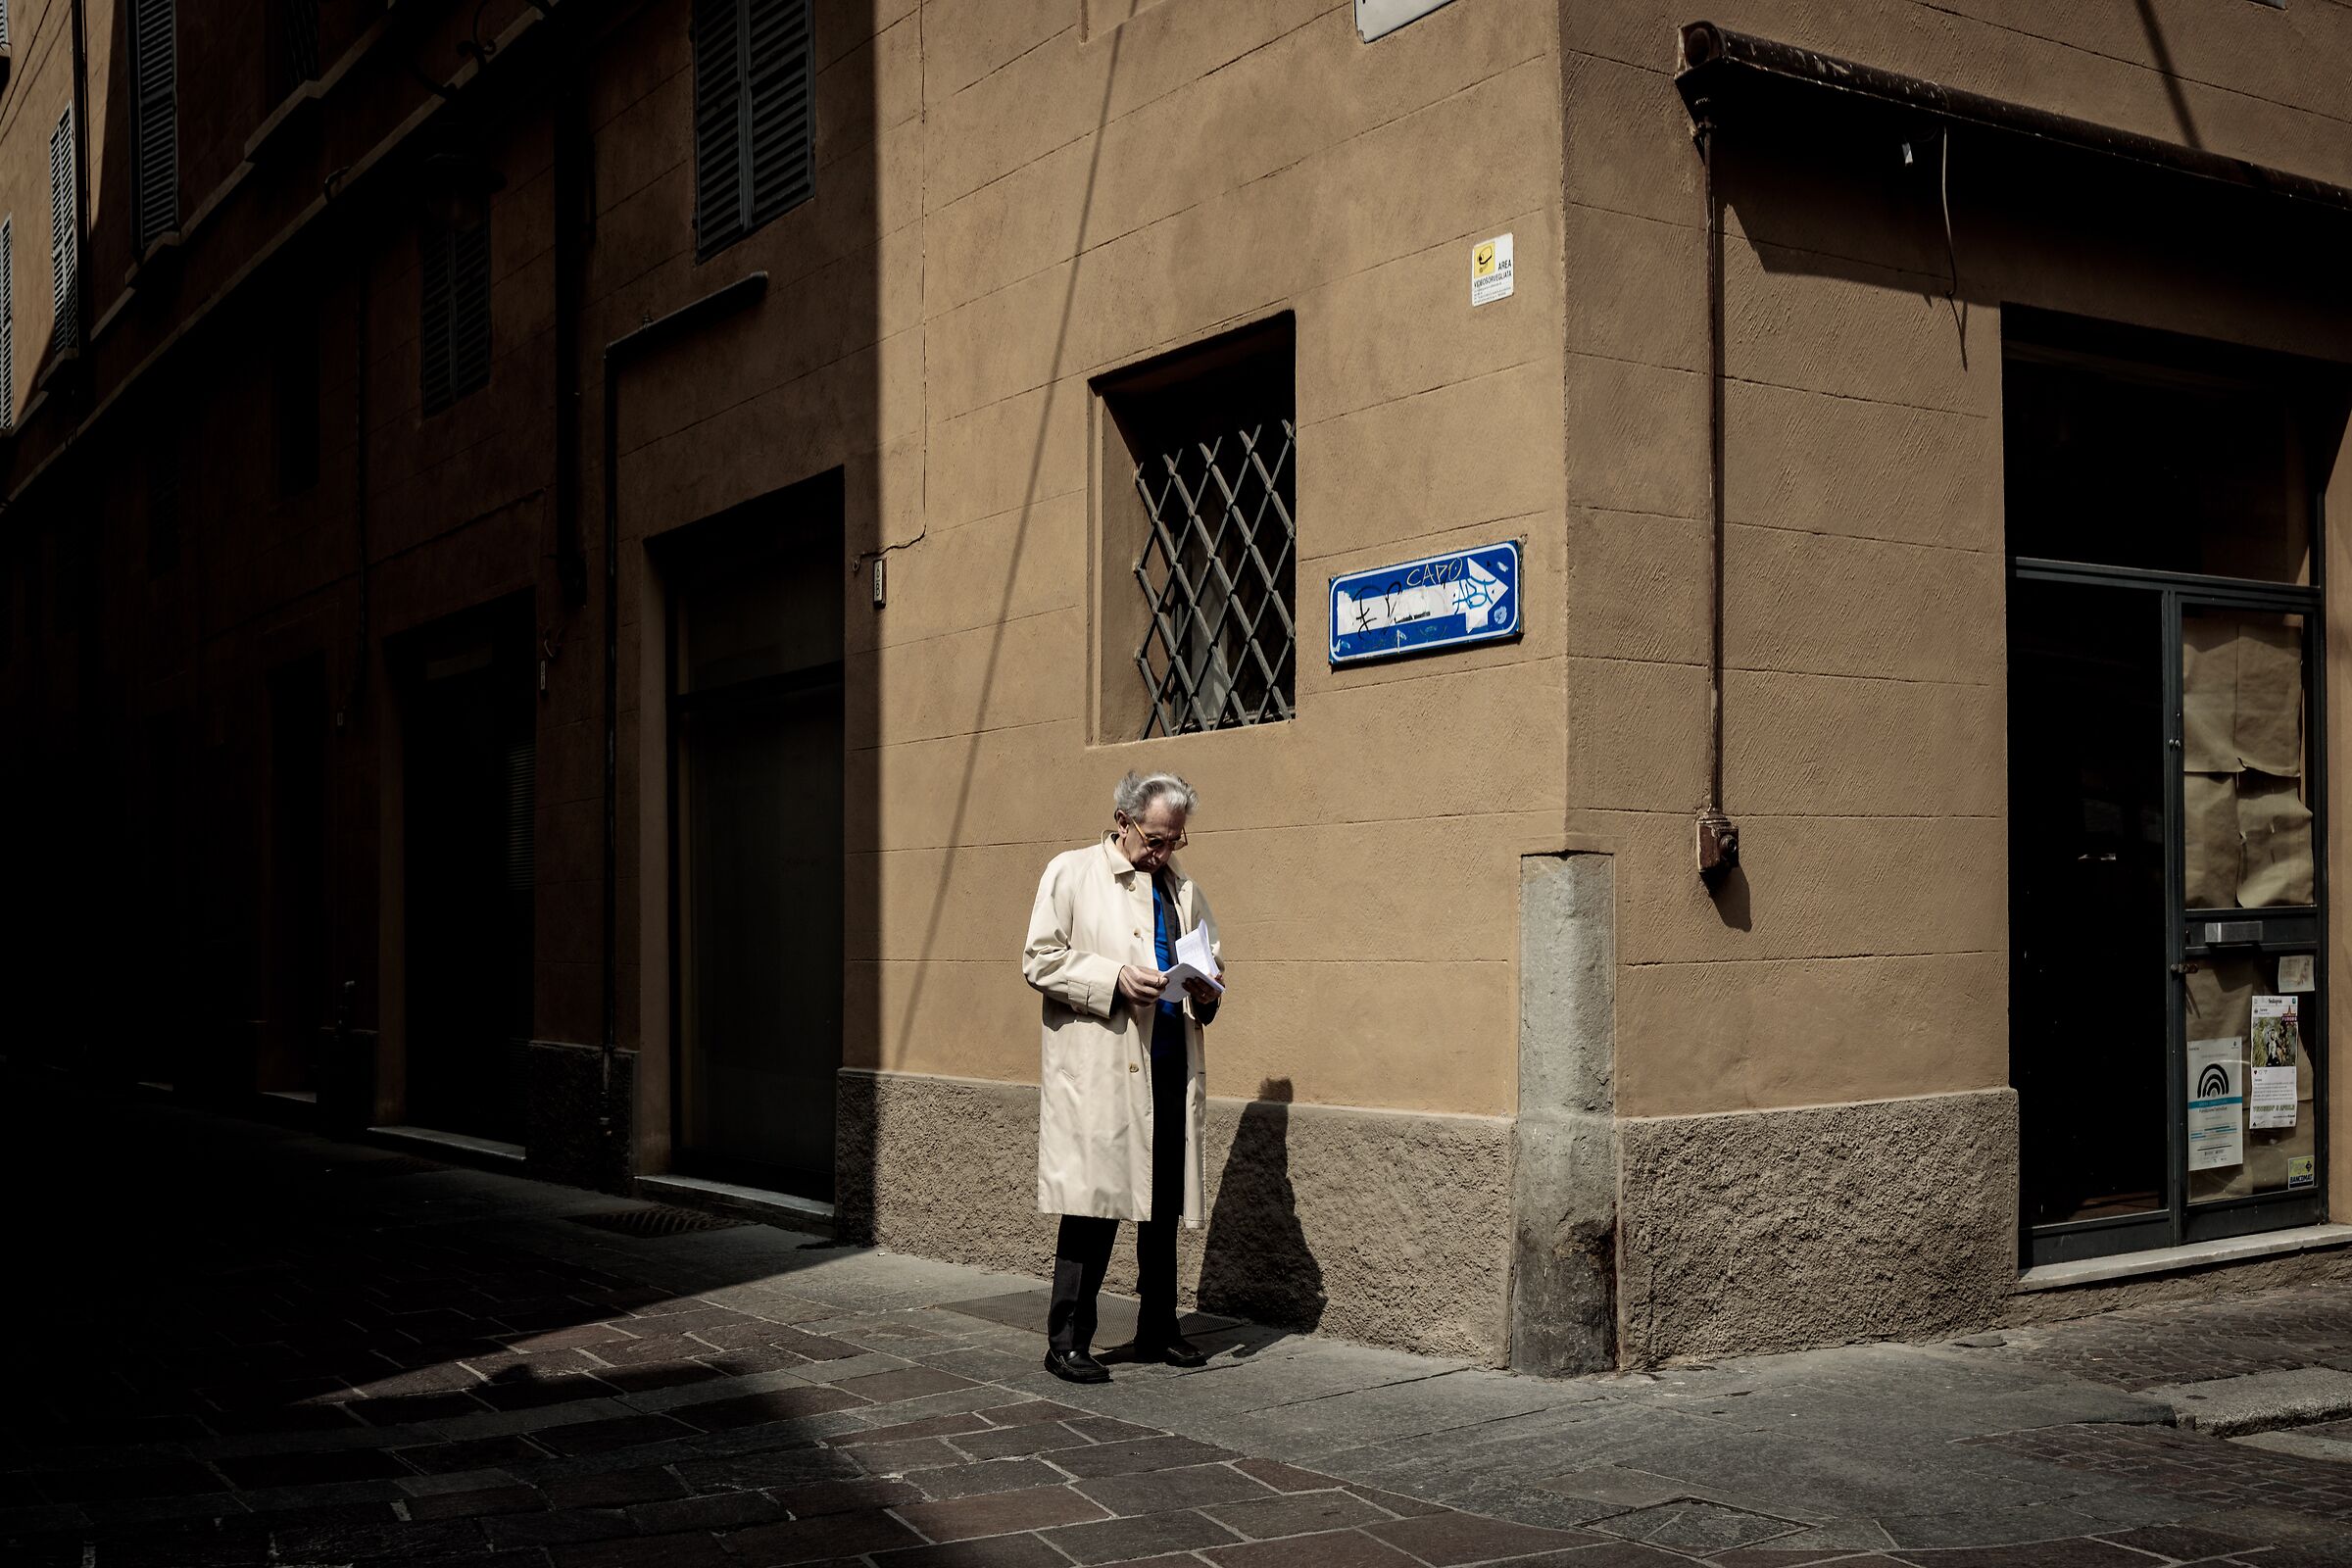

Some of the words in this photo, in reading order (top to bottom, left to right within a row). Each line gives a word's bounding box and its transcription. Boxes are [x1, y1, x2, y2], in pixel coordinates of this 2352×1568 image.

[1498, 260, 1512, 270] AREA
[1473, 270, 1512, 288] VIDEOSORVEGLIATA
[1405, 557, 1463, 587] CAPO
[2289, 1173, 2313, 1183] BANCOMAT
